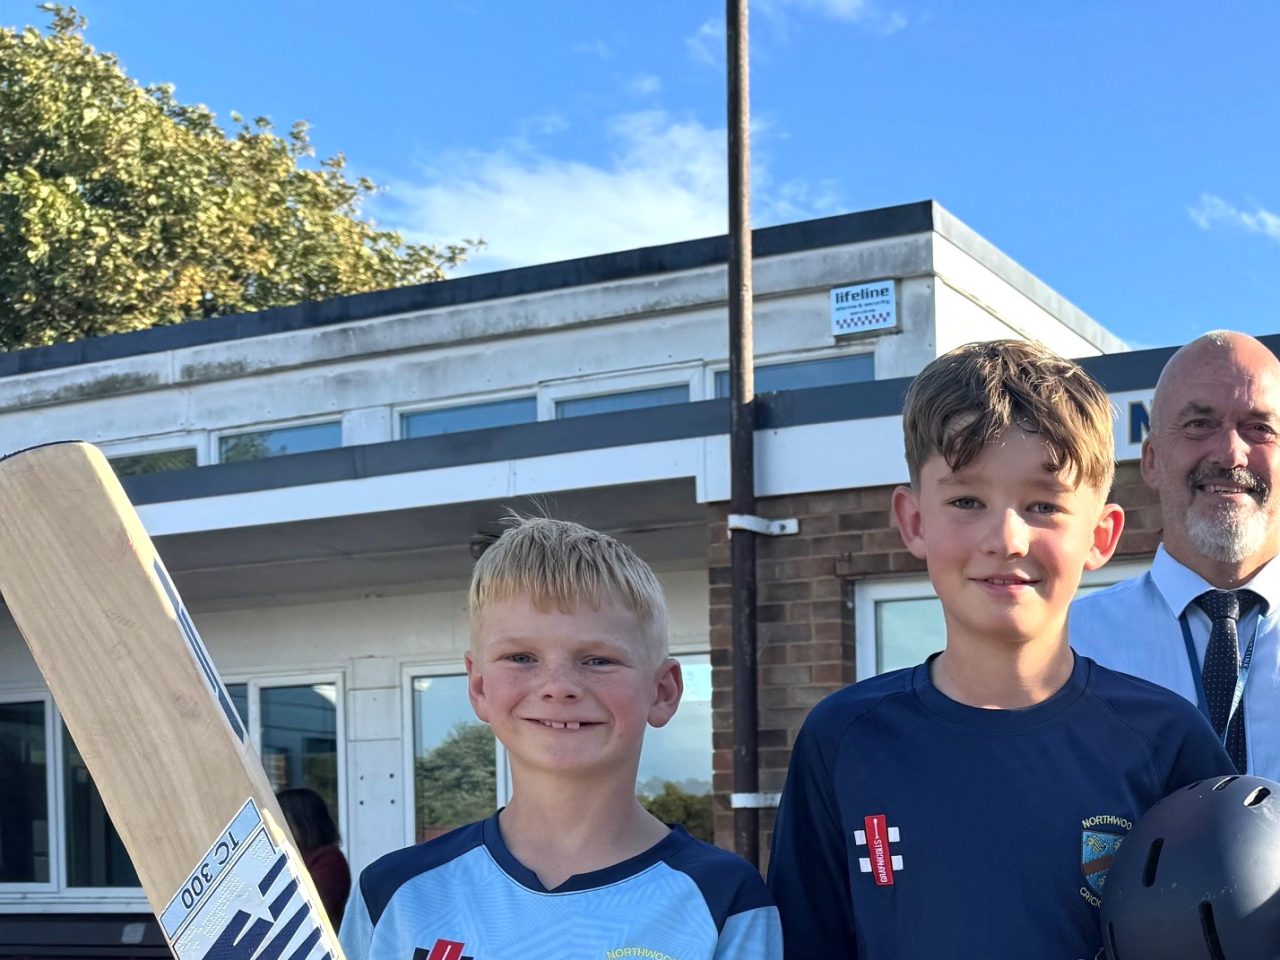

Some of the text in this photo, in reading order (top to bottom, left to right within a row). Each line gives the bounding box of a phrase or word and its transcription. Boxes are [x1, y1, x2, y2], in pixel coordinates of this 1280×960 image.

[836, 287, 889, 304] lifeline
[1081, 815, 1133, 831] NORTHWOO
[181, 830, 240, 910] TC 300
[1080, 886, 1102, 909] CRICK
